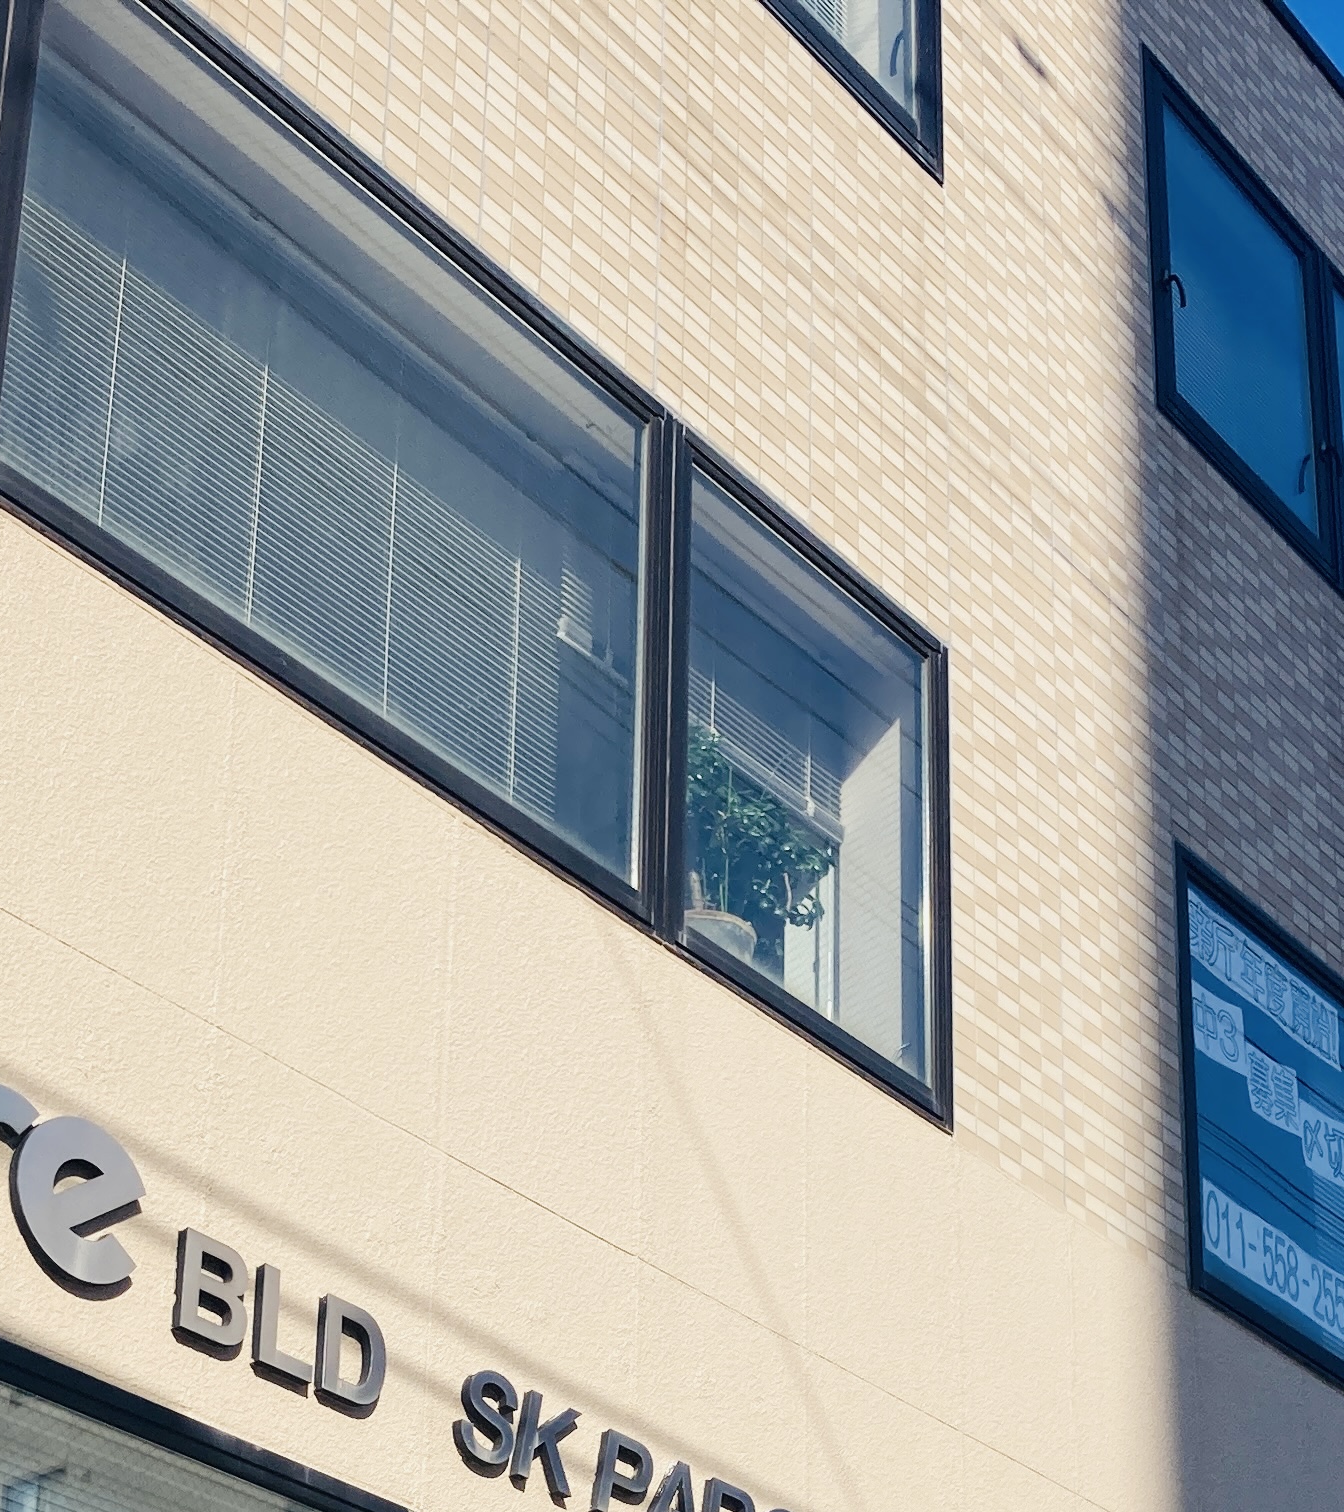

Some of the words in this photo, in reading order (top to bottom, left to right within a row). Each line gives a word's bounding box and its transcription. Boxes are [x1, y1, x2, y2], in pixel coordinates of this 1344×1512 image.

[1192, 992, 1240, 1064] 中3
[1248, 1051, 1300, 1132] 募集
[171, 1226, 386, 1420] BLD
[453, 1370, 582, 1510] SK
